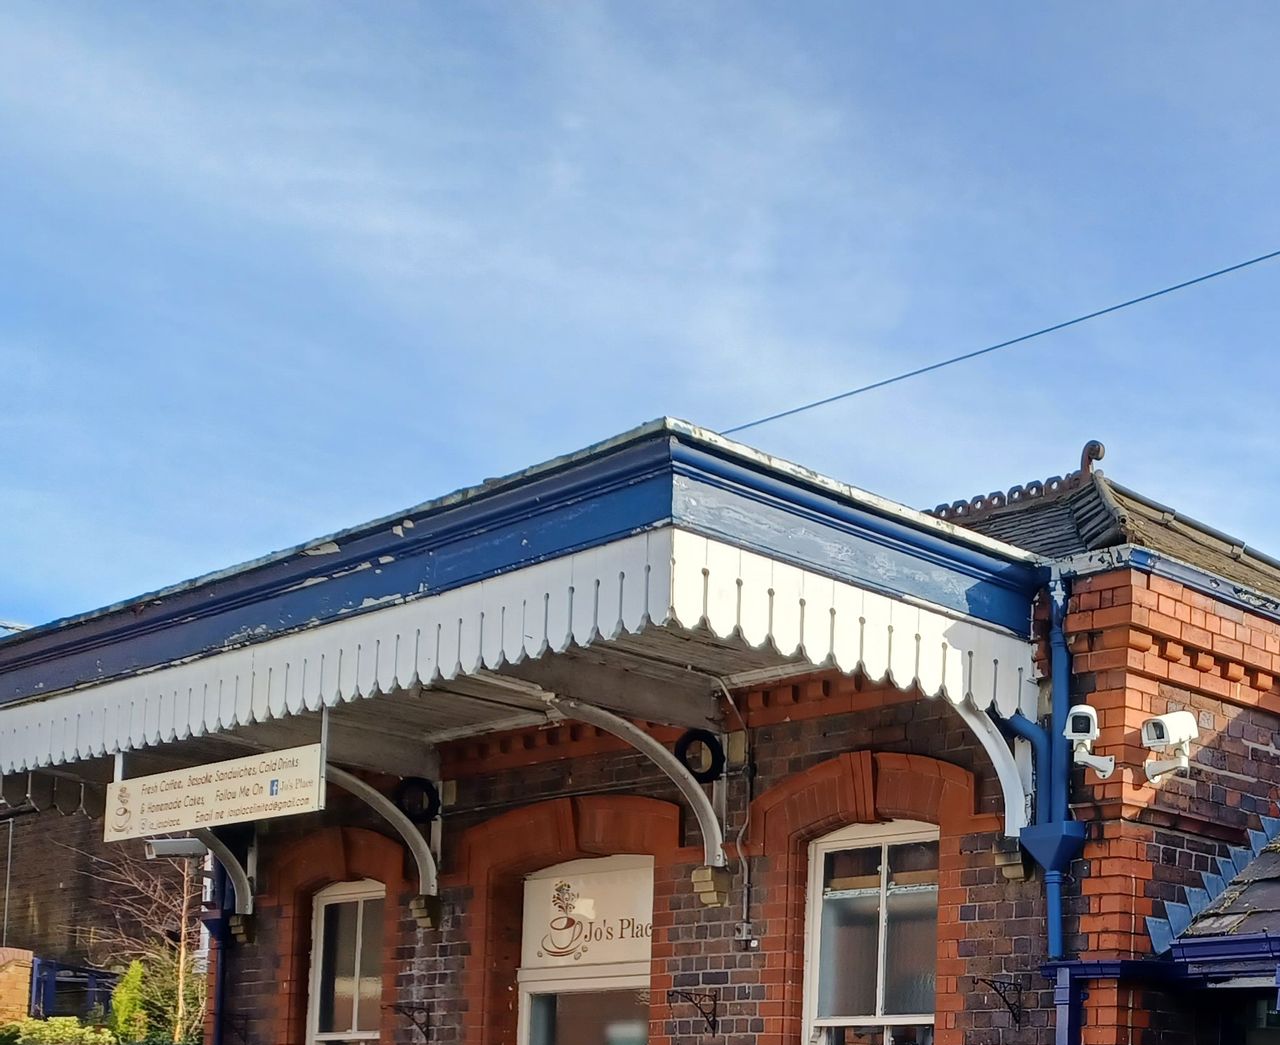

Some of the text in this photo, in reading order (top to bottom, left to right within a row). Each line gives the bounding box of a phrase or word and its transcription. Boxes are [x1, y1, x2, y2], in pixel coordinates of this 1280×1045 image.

[259, 759, 277, 774] Cold
[278, 757, 299, 770] Drinks
[215, 783, 264, 801] Follow Me On
[195, 809, 214, 823] Email
[584, 919, 614, 942] Jo's
